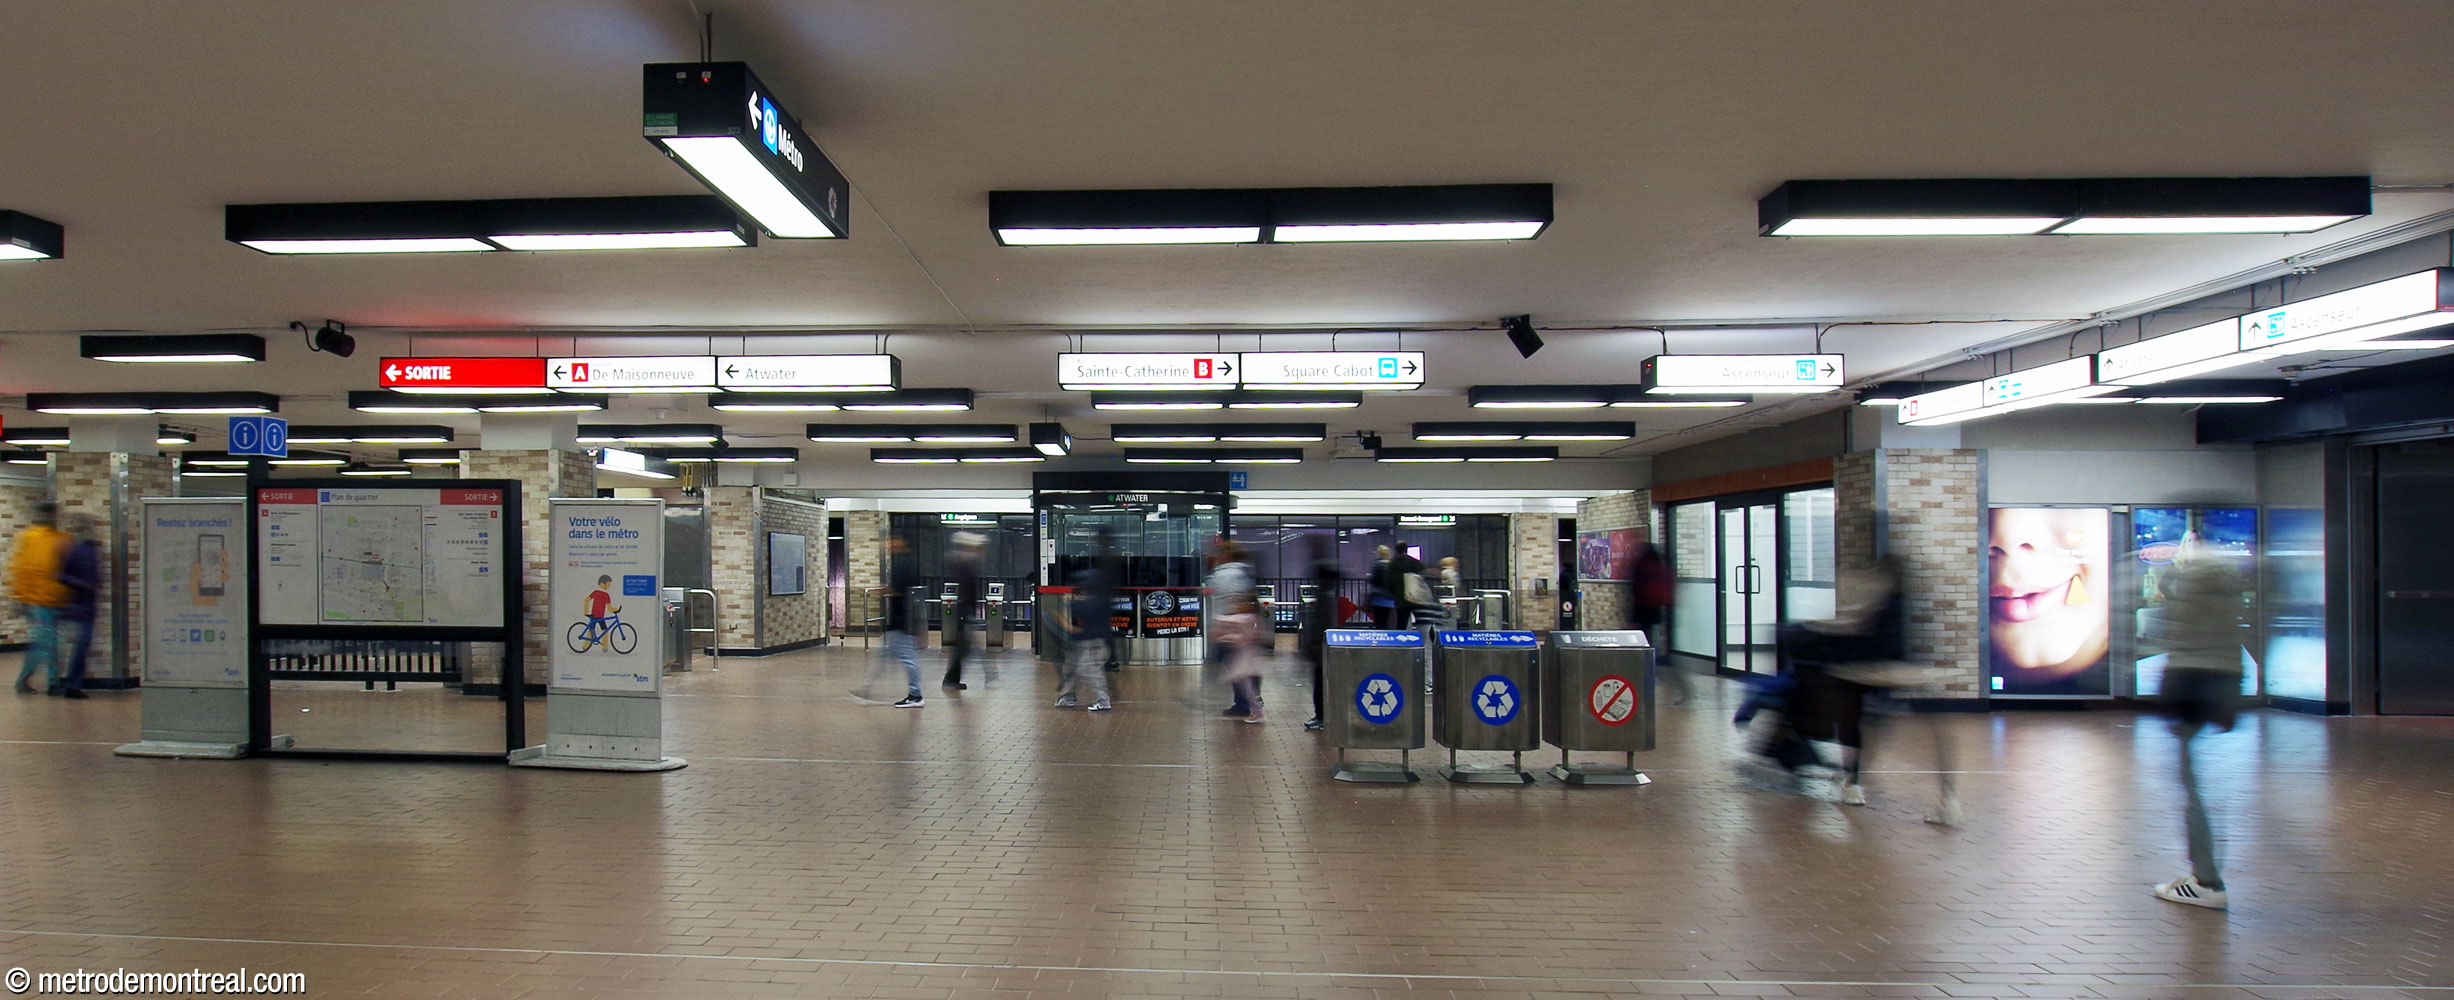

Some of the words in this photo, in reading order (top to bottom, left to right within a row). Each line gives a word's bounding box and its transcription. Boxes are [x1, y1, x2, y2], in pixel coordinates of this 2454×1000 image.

[778, 123, 804, 173] Métro
[2290, 306, 2360, 331] Ascenseur
[404, 365, 452, 380] SORTIE
[574, 364, 587, 380] A
[592, 368, 609, 381] De
[612, 367, 695, 380] Maisonneuve
[745, 367, 797, 380] Atwater
[1077, 364, 1190, 378] Sainte-Catherine
[1197, 361, 1210, 377] B
[1283, 364, 1329, 381] Square
[1333, 364, 1373, 377] Cabot
[1722, 366, 1791, 379] Ascenseur
[271, 492, 293, 500] SORTIE
[354, 493, 378, 502] quartier
[464, 493, 489, 501] SORTIE
[1115, 494, 1149, 502] ATWATER
[568, 516, 596, 527] Votre
[599, 516, 621, 527] vélo
[568, 528, 593, 539] dans
[596, 528, 605, 539] le
[608, 528, 639, 539] métro
